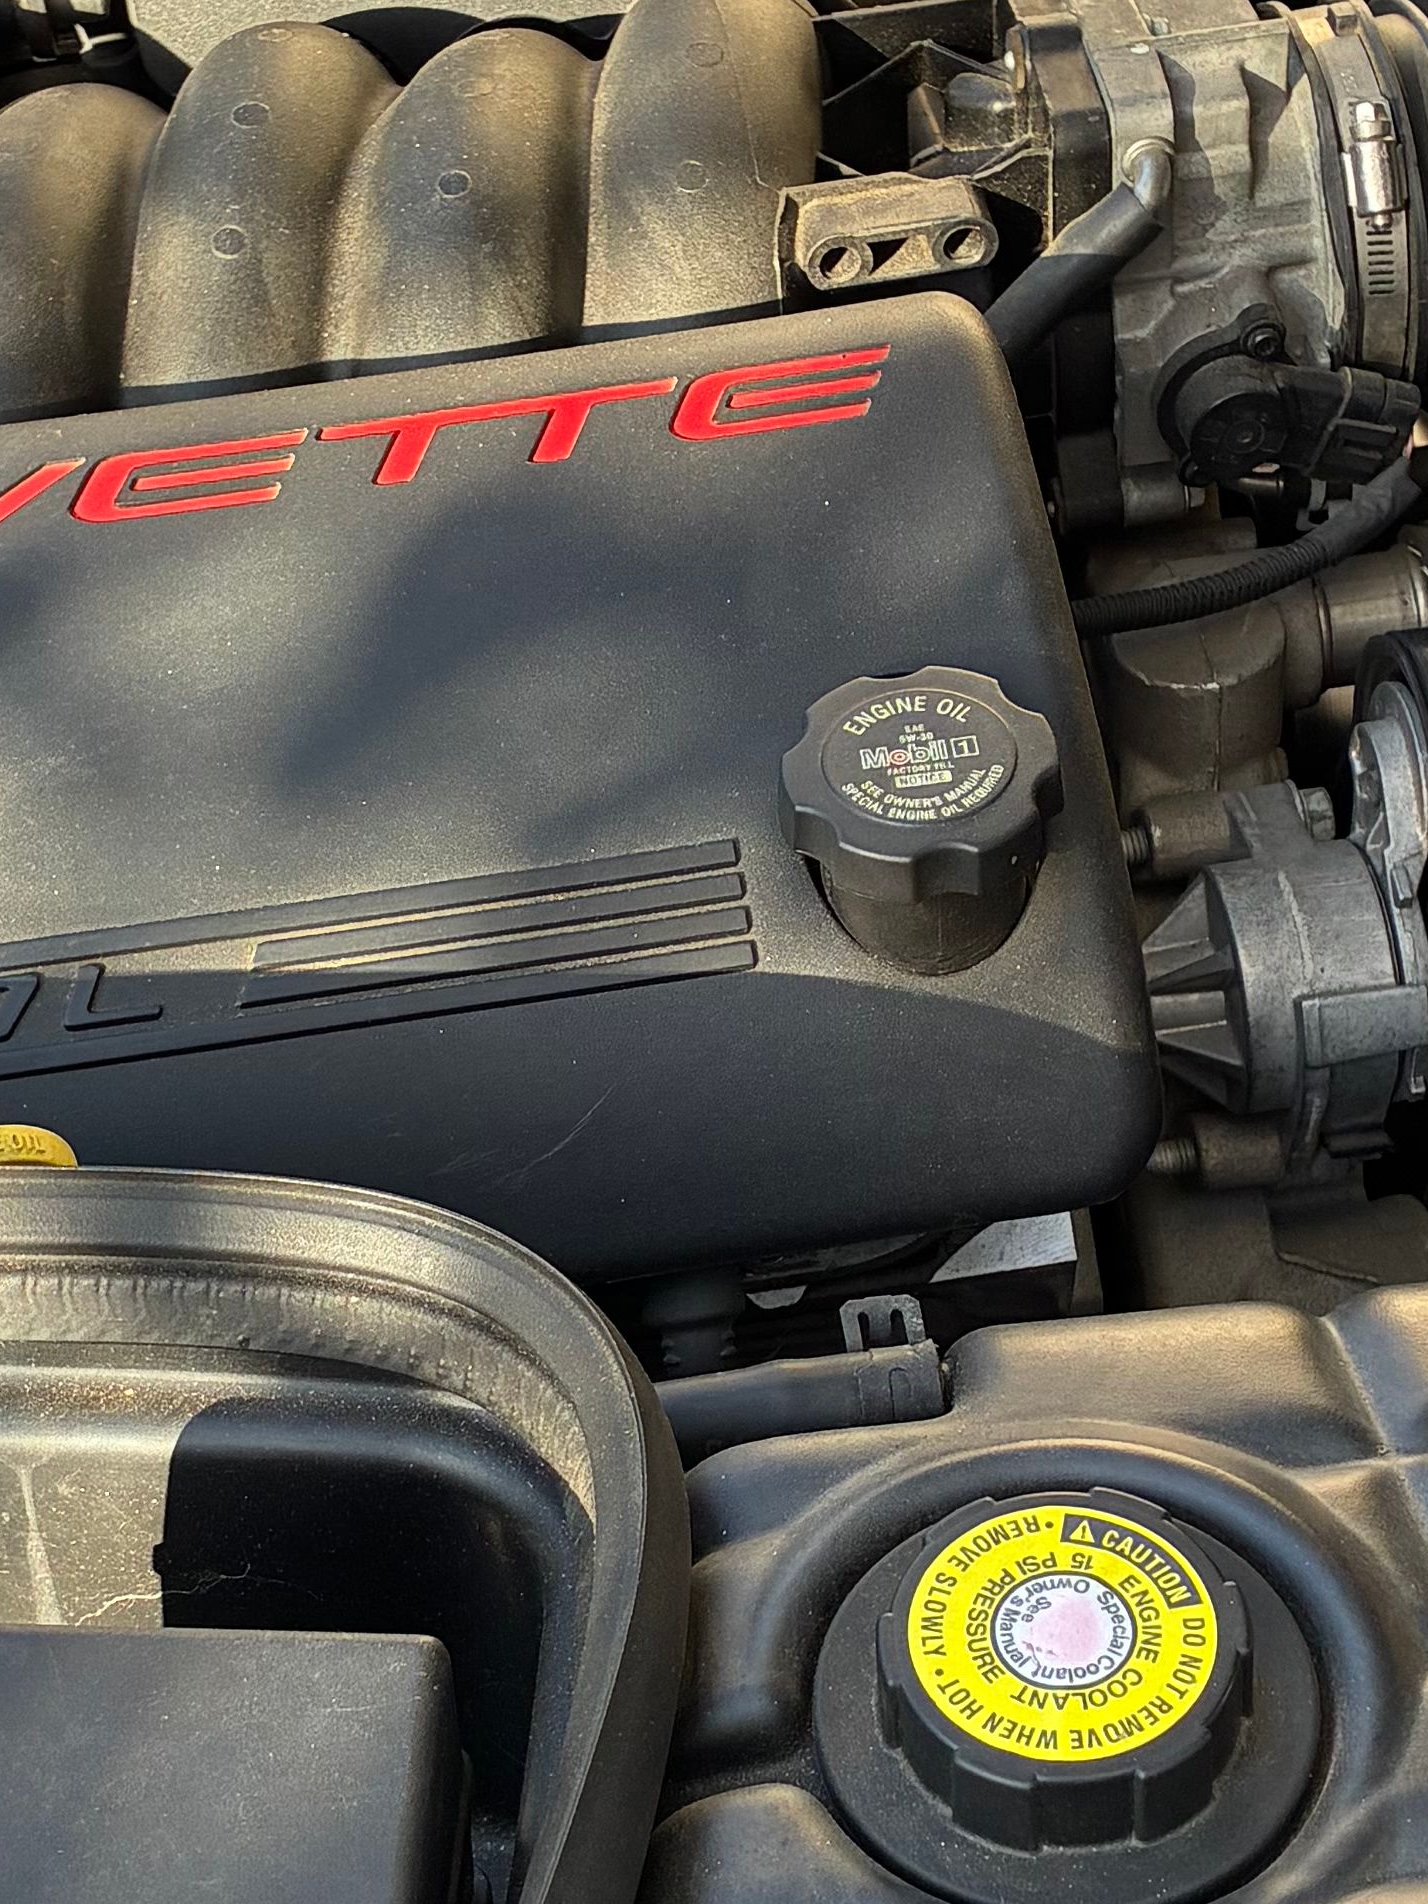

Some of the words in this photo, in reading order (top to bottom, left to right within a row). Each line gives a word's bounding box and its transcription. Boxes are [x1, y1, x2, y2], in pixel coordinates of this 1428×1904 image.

[842, 695, 927, 737] ENGINE
[935, 697, 973, 724] OIL
[859, 738, 948, 770] Mobil
[841, 781, 884, 816] SPECIAL
[887, 806, 938, 821] ENGINE
[940, 803, 963, 818] OIL
[961, 763, 1006, 811] REQUIRED
[860, 780, 883, 799] SEE
[943, 767, 988, 802] MANUAL
[897, 772, 950, 787] NOTICE
[11, 1133, 47, 1155] OIL
[948, 1514, 1040, 1573] REMOVE
[1070, 1552, 1095, 1571] 15
[1014, 1551, 1058, 1585] PSI
[1100, 1527, 1192, 1605] CAUTION
[1009, 1577, 1091, 1607] Owner's
[1021, 1596, 1052, 1623] See
[921, 1572, 957, 1658] SLOWLY
[967, 1567, 1016, 1685] PRESSURE
[1096, 1590, 1130, 1657] Special
[1117, 1573, 1163, 1664] ENGINE
[1182, 1616, 1207, 1648] DO
[999, 1606, 1032, 1669] Manual
[1011, 1667, 1144, 1712] COOLANT
[1030, 1654, 1116, 1684] Coolant
[1170, 1652, 1204, 1701] NOT
[938, 1678, 978, 1721] HOT
[982, 1711, 1059, 1751] WHEN
[1069, 1695, 1173, 1751] REMOVE
